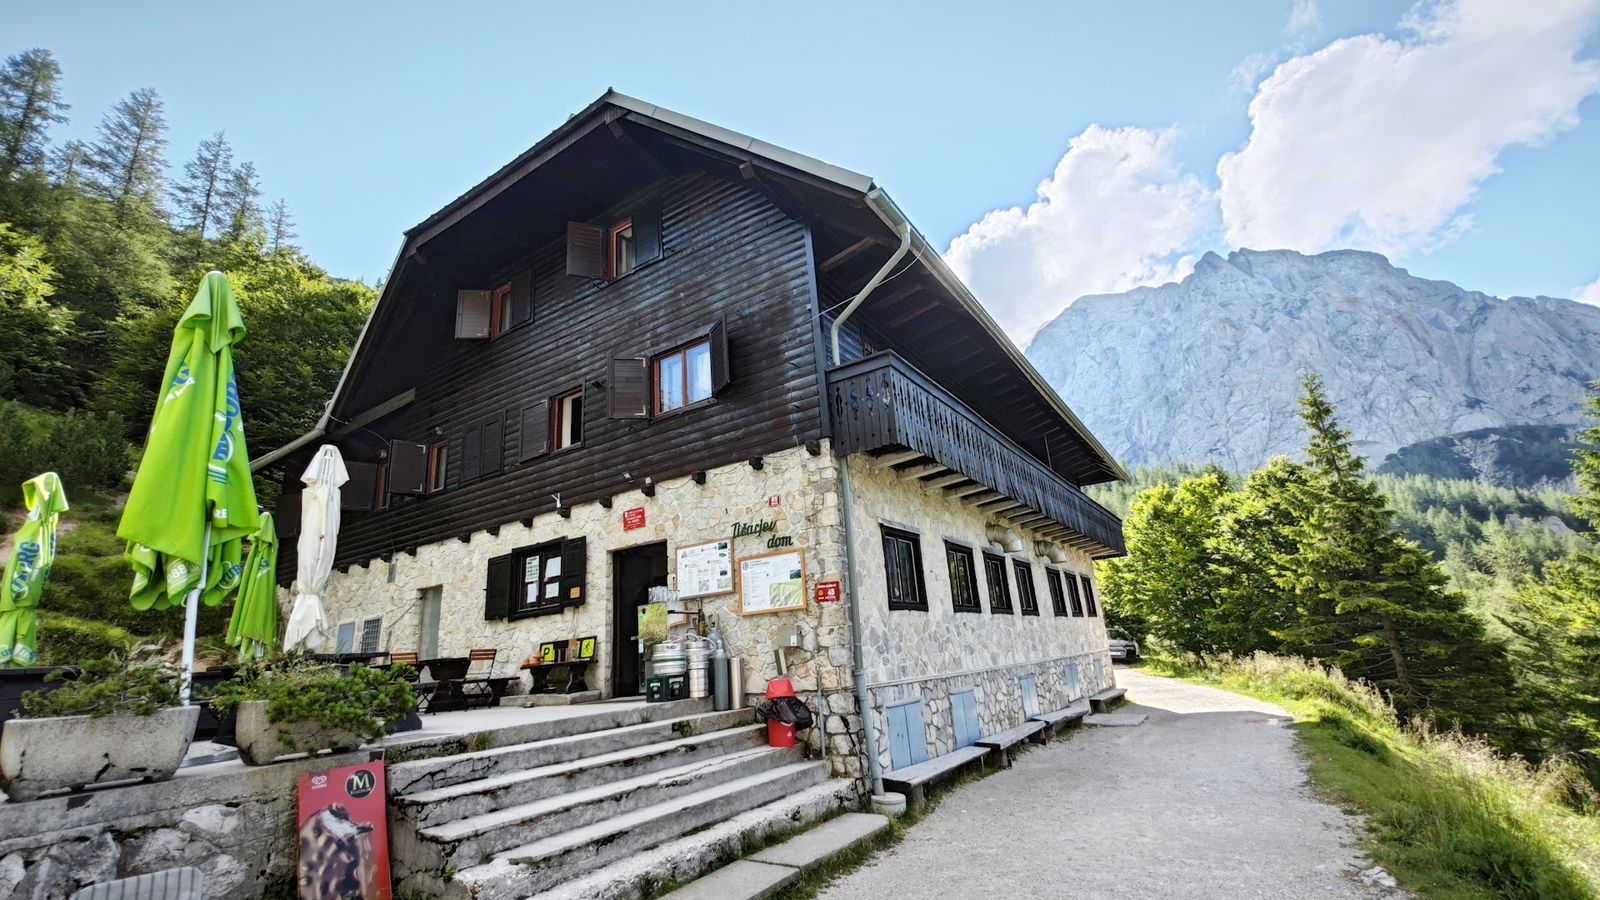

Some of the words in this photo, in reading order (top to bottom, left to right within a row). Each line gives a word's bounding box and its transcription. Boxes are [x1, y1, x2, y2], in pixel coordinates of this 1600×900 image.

[731, 519, 777, 538] Tičarjev
[767, 534, 793, 548] dom
[350, 773, 370, 790] M
